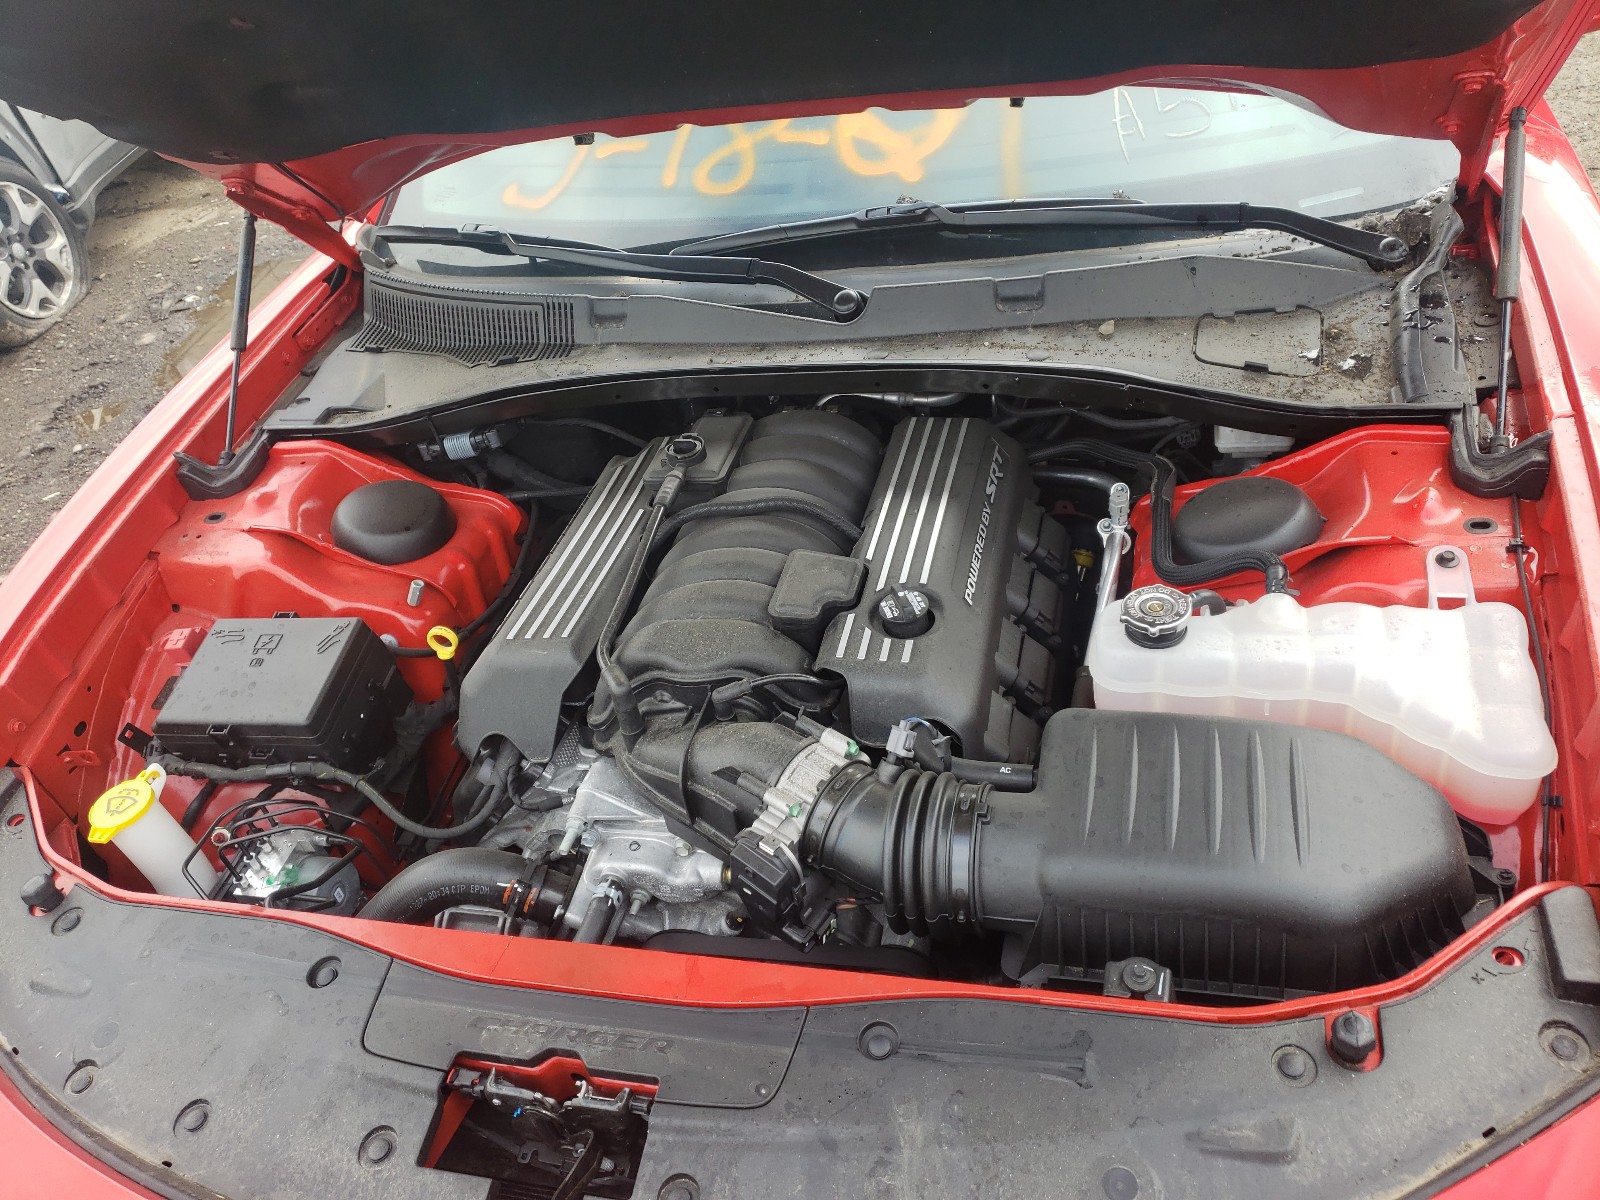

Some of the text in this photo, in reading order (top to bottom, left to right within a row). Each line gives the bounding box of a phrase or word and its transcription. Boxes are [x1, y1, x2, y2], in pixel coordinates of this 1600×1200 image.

[964, 445, 1004, 606] POWERED BY SRT
[999, 766, 1012, 774] AC
[470, 884, 490, 895] EPDM
[465, 1015, 677, 1053] CARGER
